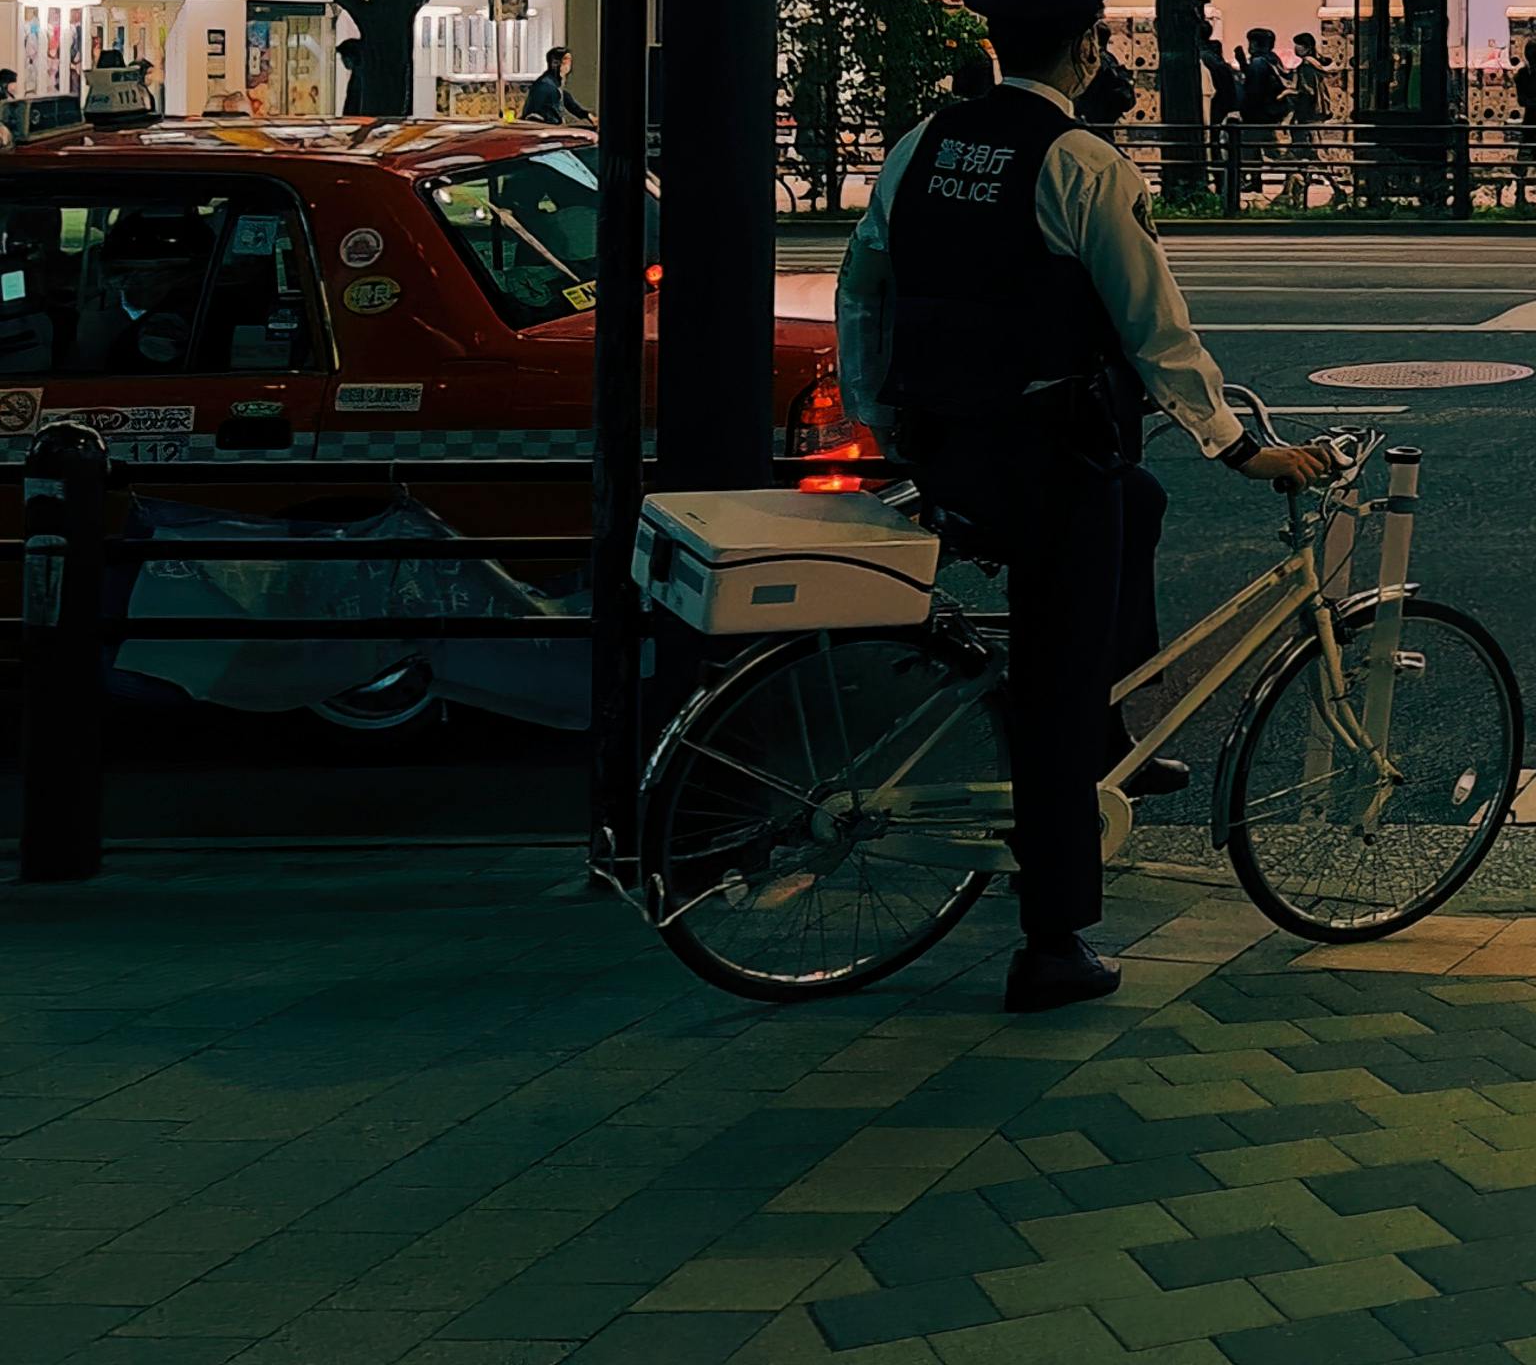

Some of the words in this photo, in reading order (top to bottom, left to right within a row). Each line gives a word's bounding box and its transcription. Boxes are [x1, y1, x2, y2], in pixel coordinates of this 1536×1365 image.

[935, 138, 1015, 175] 警視庁
[929, 175, 1001, 203] POLICE
